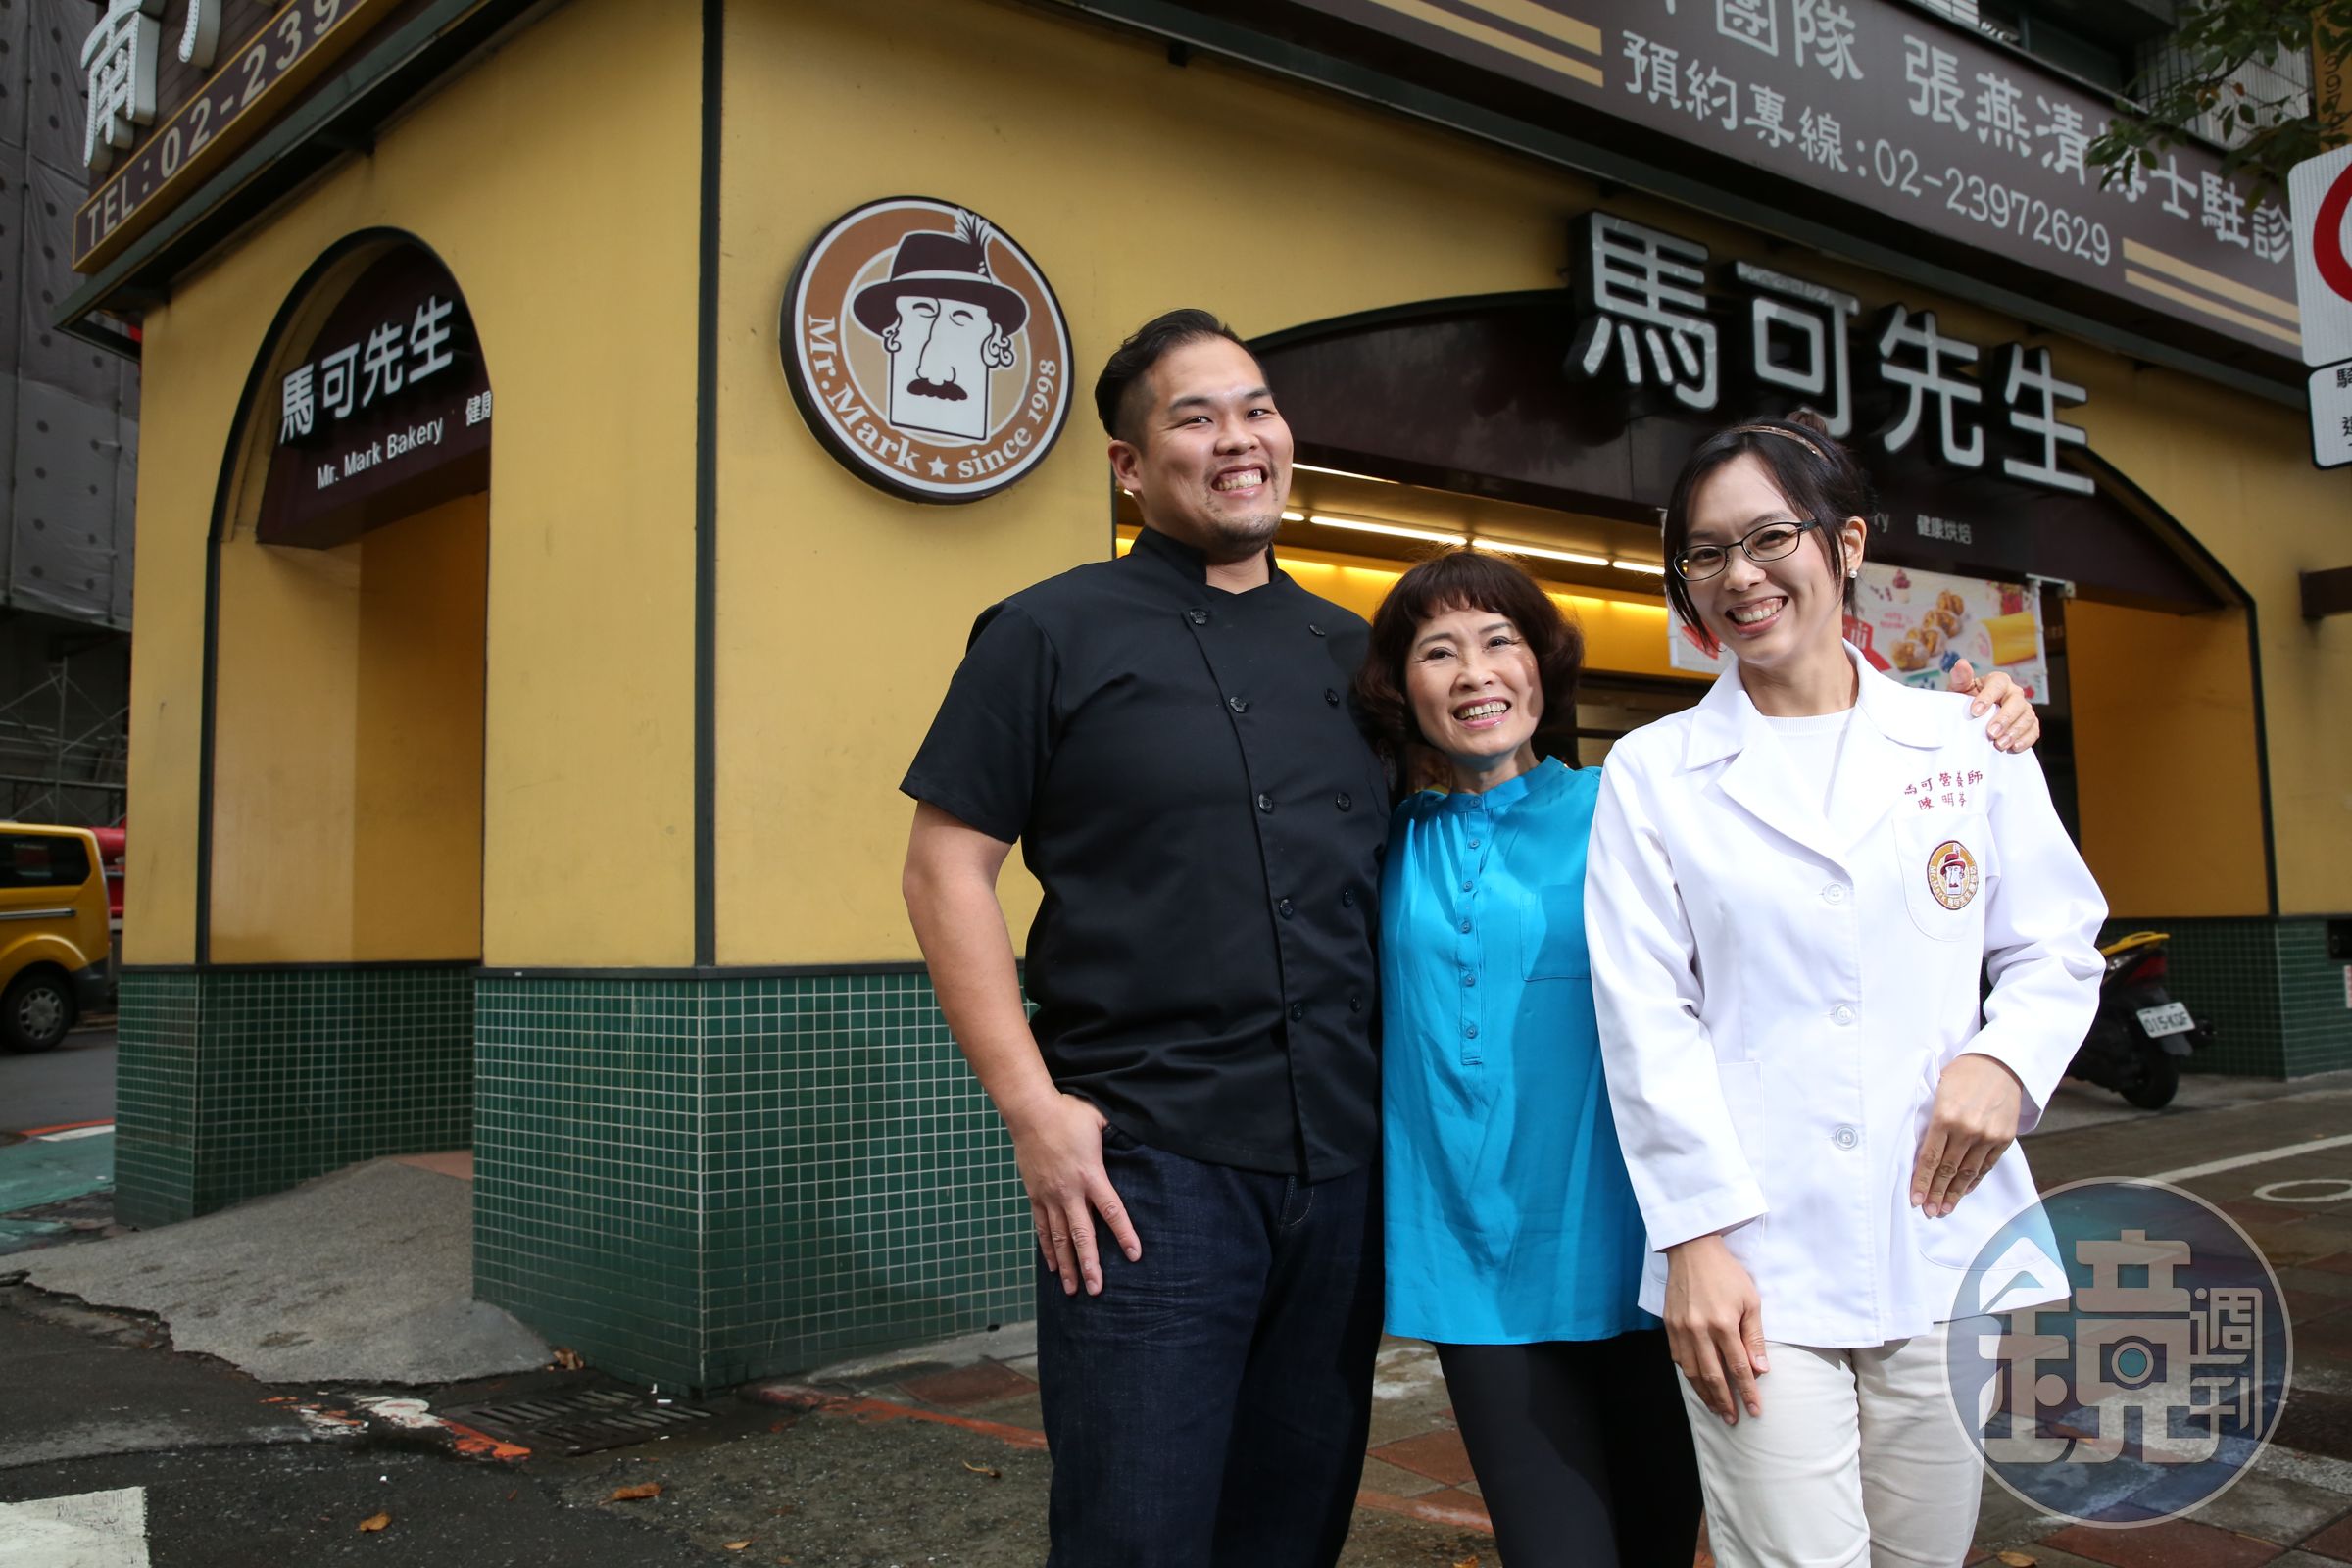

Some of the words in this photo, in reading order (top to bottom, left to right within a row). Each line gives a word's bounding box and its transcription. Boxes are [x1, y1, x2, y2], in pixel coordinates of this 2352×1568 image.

[280, 295, 453, 445] 馬可先生
[956, 426, 1033, 480] since
[1027, 358, 1057, 424] 1998
[1582, 210, 2095, 496] 馬可先生
[318, 464, 340, 490] Mr.
[344, 442, 382, 478] Mark
[387, 417, 444, 461] Bakery
